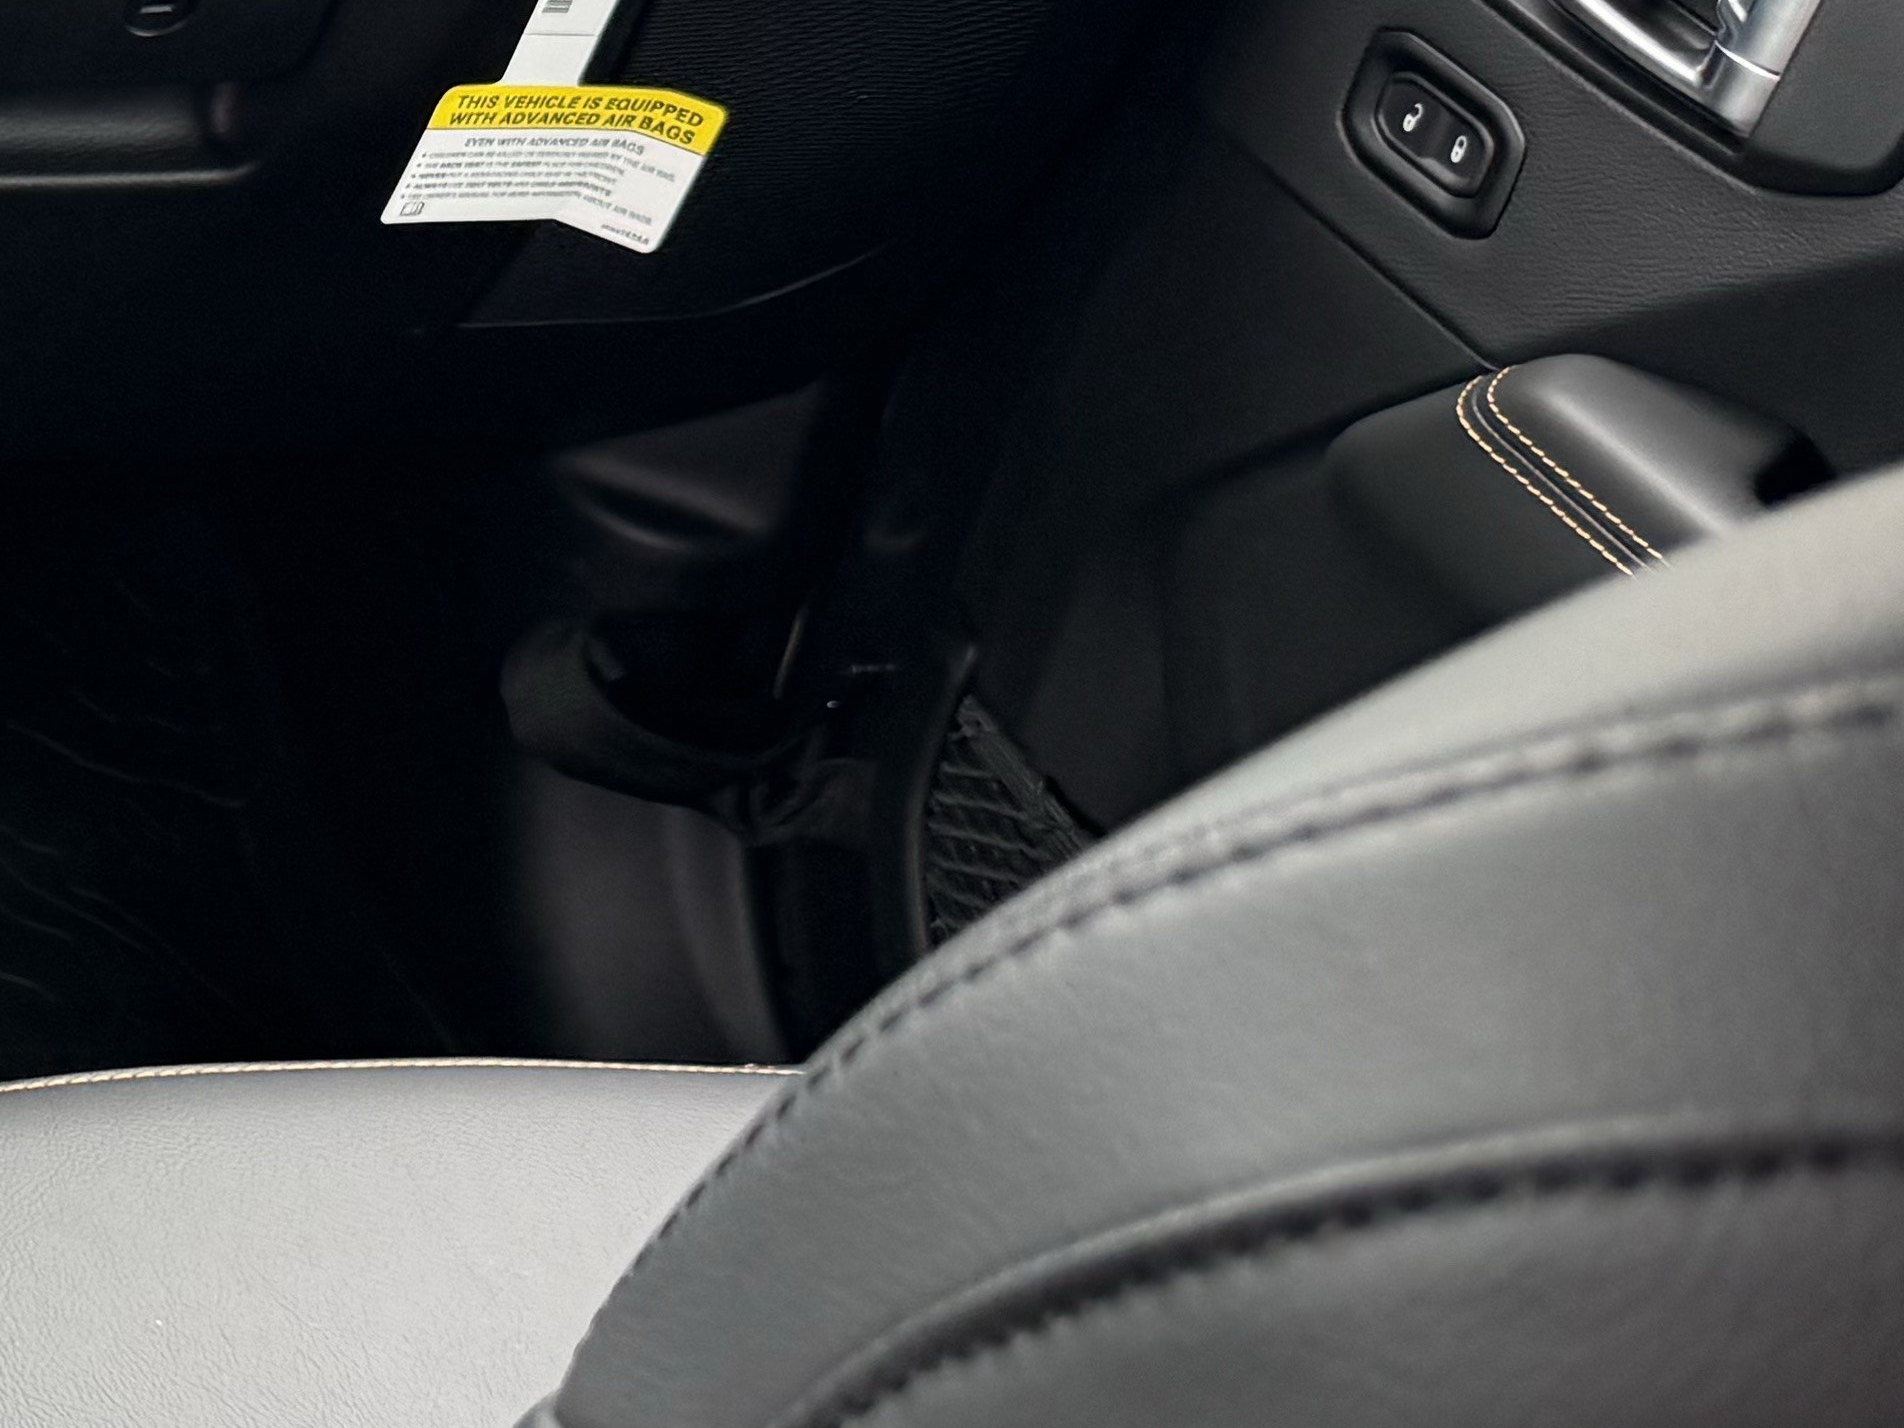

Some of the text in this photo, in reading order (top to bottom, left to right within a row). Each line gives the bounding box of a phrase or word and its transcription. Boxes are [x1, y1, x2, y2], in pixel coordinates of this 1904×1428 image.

[457, 95, 704, 128] THIS VEHICLE IS EQUIPPED
[449, 112, 696, 145] WITH ADVANCED AIR BAGS
[464, 137, 493, 148] EVEN
[497, 137, 526, 148] WITH
[528, 137, 588, 149] ADVANCED
[589, 137, 610, 148] AIR
[610, 138, 645, 156] BAGS
